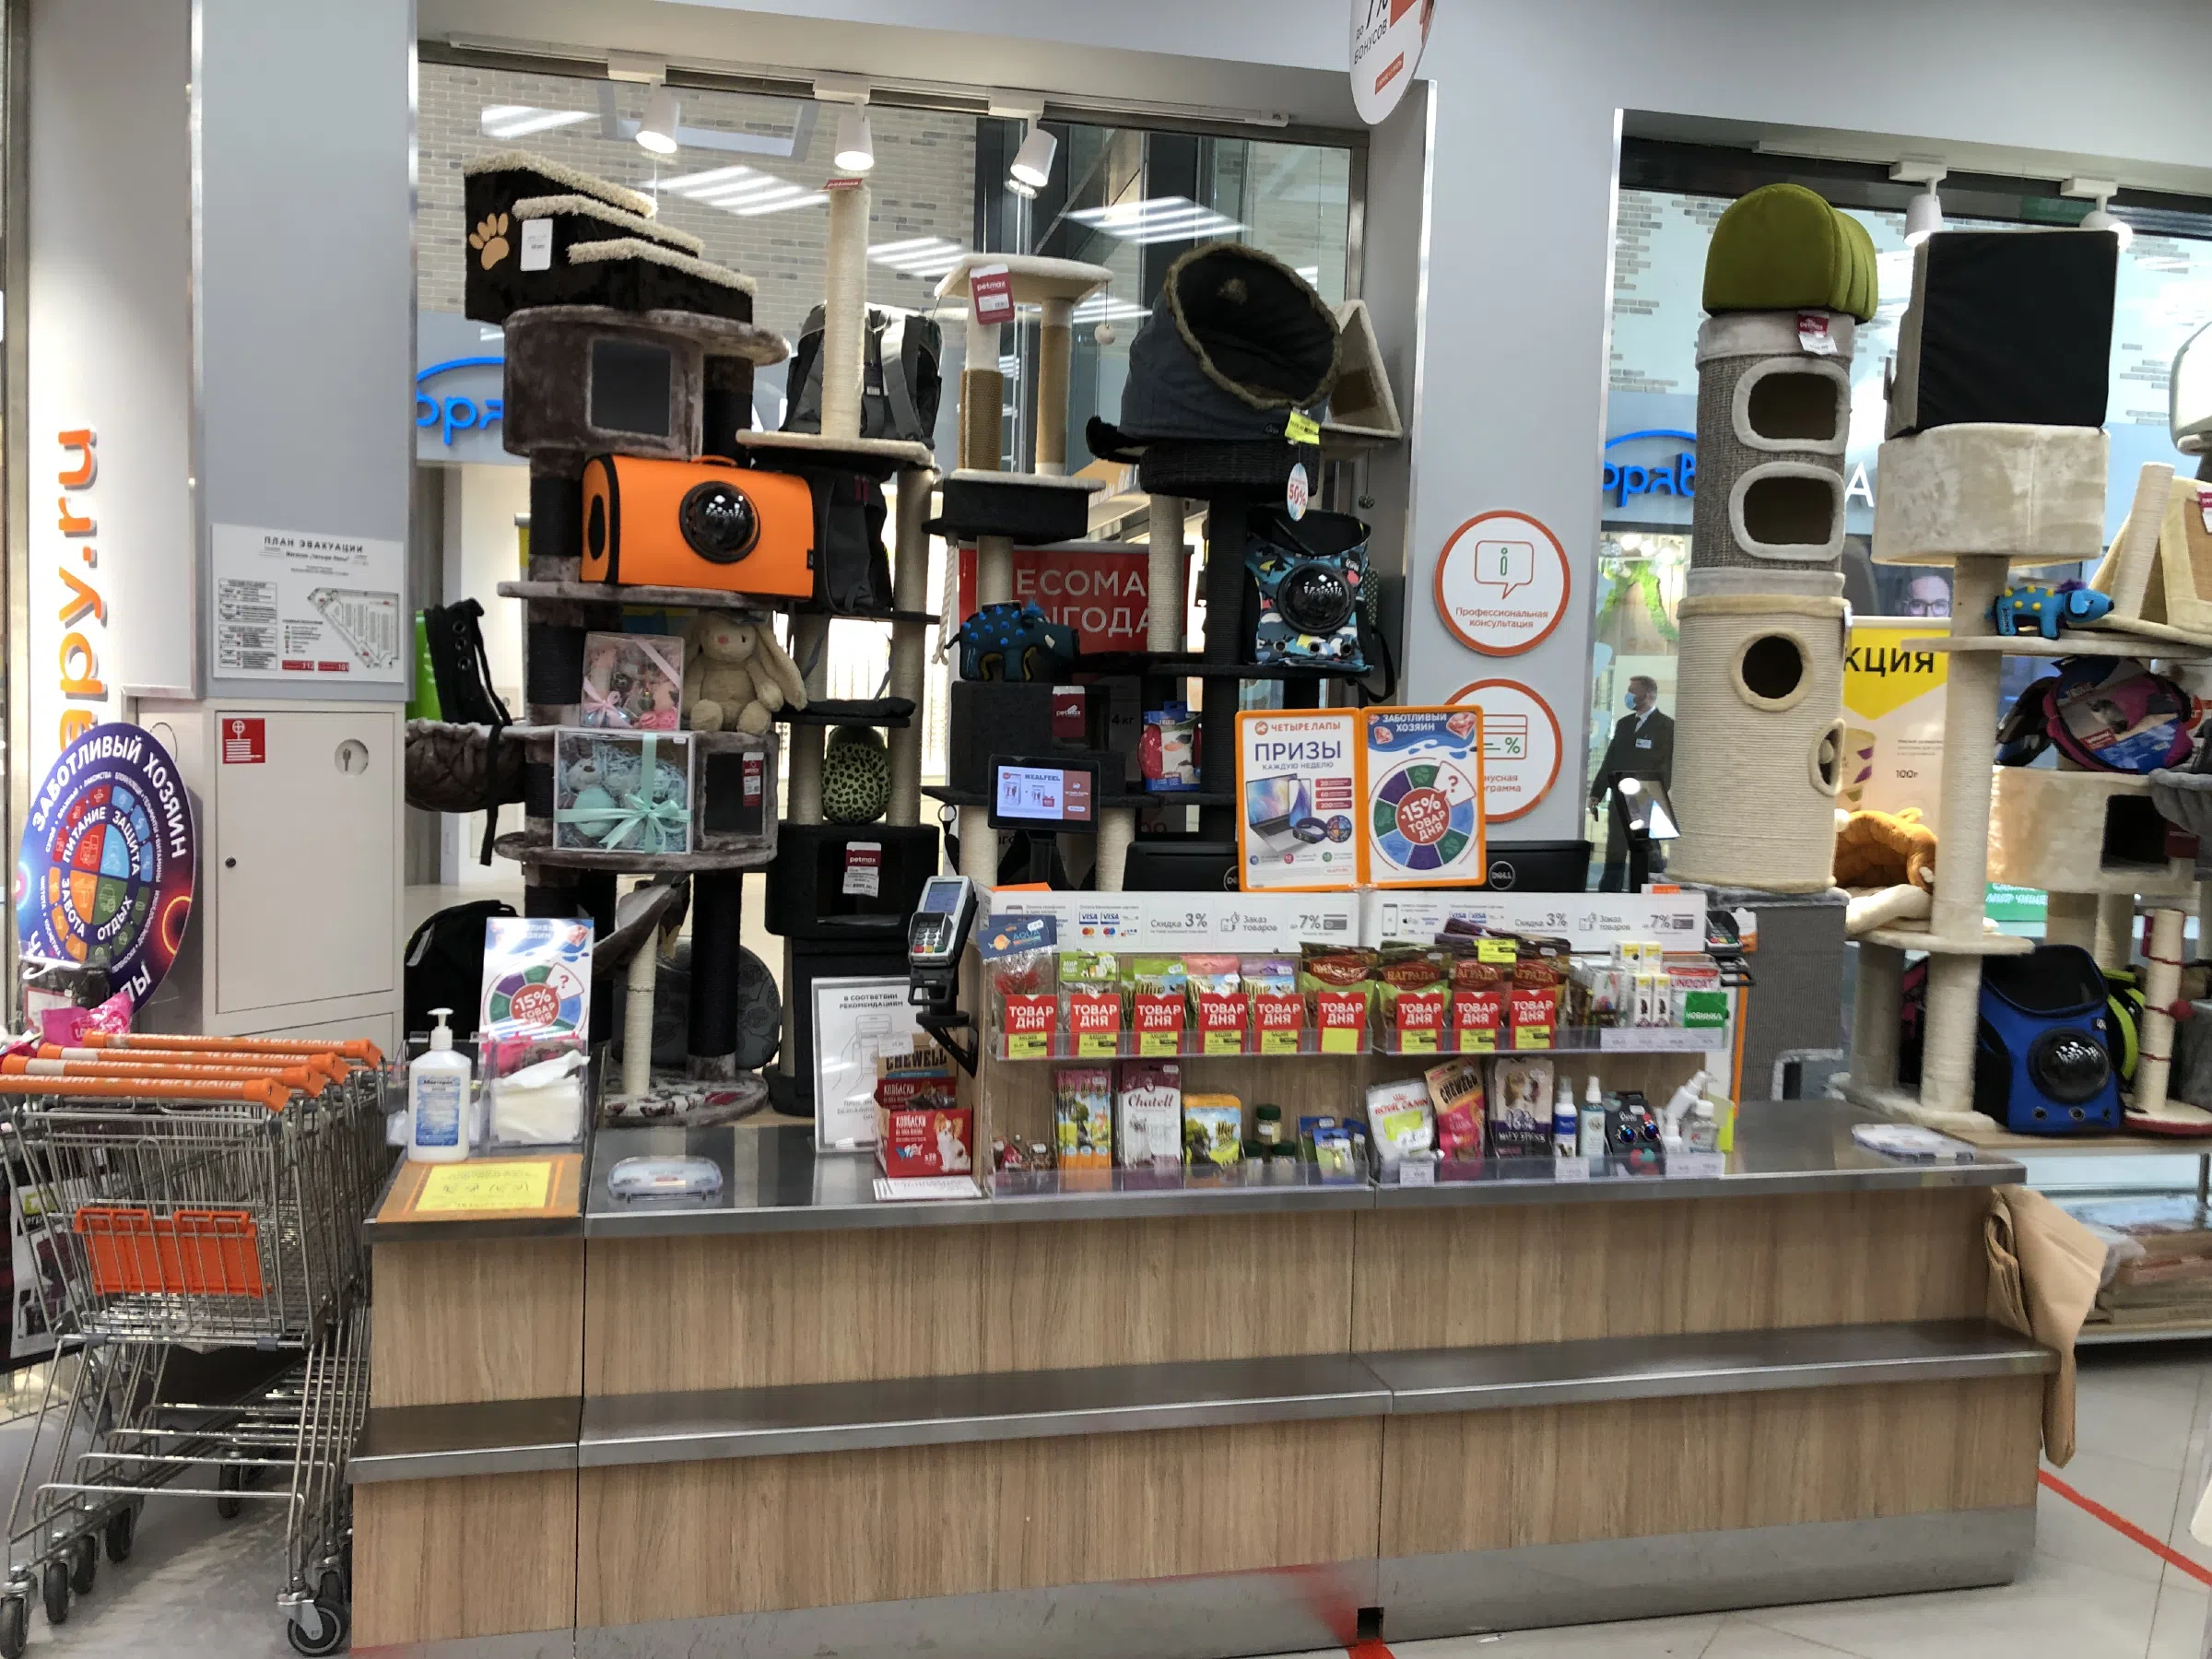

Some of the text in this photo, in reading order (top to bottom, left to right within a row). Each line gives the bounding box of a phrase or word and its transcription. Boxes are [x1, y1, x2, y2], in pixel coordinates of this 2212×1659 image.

[1354, 18, 1387, 65] БОНУСОВ
[977, 280, 1006, 292] petmax
[264, 535, 363, 553] ПЛАН ЭВАКУАЦИИ
[1017, 569, 1147, 596] ЕСОМА
[59, 429, 104, 754] apy.ru
[1456, 607, 1548, 618] Профессиональная
[1054, 606, 1149, 638] ГОДА
[1469, 618, 1534, 629] консультация
[1843, 647, 1935, 677] КЦИЯ
[1382, 712, 1447, 723] ЗАБОТЛИВЫЙ
[1271, 722, 1341, 731] ЧЕТЫРЕ ЛАПЫ
[1395, 723, 1435, 733] ХОЗЯИН
[1255, 741, 1341, 762] ПРИЗЫ
[1262, 761, 1335, 771] КАЖДУЮ НЕДЕЛЮ
[1448, 774, 1459, 794] ?
[32, 735, 187, 858] ЗАБОТЛИВЫЙ ХОЗЯИН
[1400, 794, 1441, 823] -15%
[1407, 811, 1446, 831] ТОВАР
[62, 806, 107, 864] ПИТАНИЕ
[1418, 824, 1444, 842] ДНЯ
[112, 810, 140, 877] ЗАЩИТА
[1491, 871, 1512, 880] DELL
[62, 877, 86, 937] ЗАБОТА
[97, 895, 134, 941] ОТДЫХ
[1151, 912, 1207, 928] Скидка 3%
[1243, 915, 1267, 924] Заказ
[1299, 914, 1321, 929] 7%
[1515, 912, 1568, 928] Скидка 3%
[1650, 914, 1671, 928] 7%
[1242, 924, 1277, 933] товаров
[1386, 971, 1438, 982] НАГРАДА
[1456, 968, 1500, 982] АГРАДА
[514, 988, 551, 1012] -15%
[840, 1001, 903, 1009] РЕКОМЕНДАЦИЯМ
[520, 1002, 556, 1019] ТОВАР
[1009, 1006, 1053, 1018] ТОВАР
[1073, 1005, 1117, 1016] ТОВАР
[1137, 1004, 1181, 1016] ТОВАР
[1202, 1003, 1244, 1014] ТОВАР
[1257, 1003, 1300, 1014] ТОВАР
[1321, 1002, 1363, 1014] ТОВАР
[1399, 1003, 1441, 1014] ТОВАР
[1456, 1003, 1498, 1014] ТОВАР
[1512, 1001, 1554, 1012] ТОВАР
[1080, 1016, 1109, 1028] ДНЯ
[1144, 1015, 1172, 1027] ДНЯ
[1208, 1014, 1236, 1026] ДНЯ
[1264, 1014, 1290, 1026] ДНЯ
[1327, 1013, 1355, 1025] ДНЯ
[1406, 1014, 1433, 1025] ДНЯ
[1462, 1014, 1488, 1025] ДНЯ
[1518, 1011, 1546, 1022] ДНЯ
[1016, 1018, 1044, 1030] ДНЯ
[884, 1084, 914, 1095] КОЛБАСКИ
[1440, 1075, 1478, 1105] CHEWELL
[1128, 1093, 1173, 1108] Chatell
[896, 1115, 926, 1128] КОЛБАСКИ
